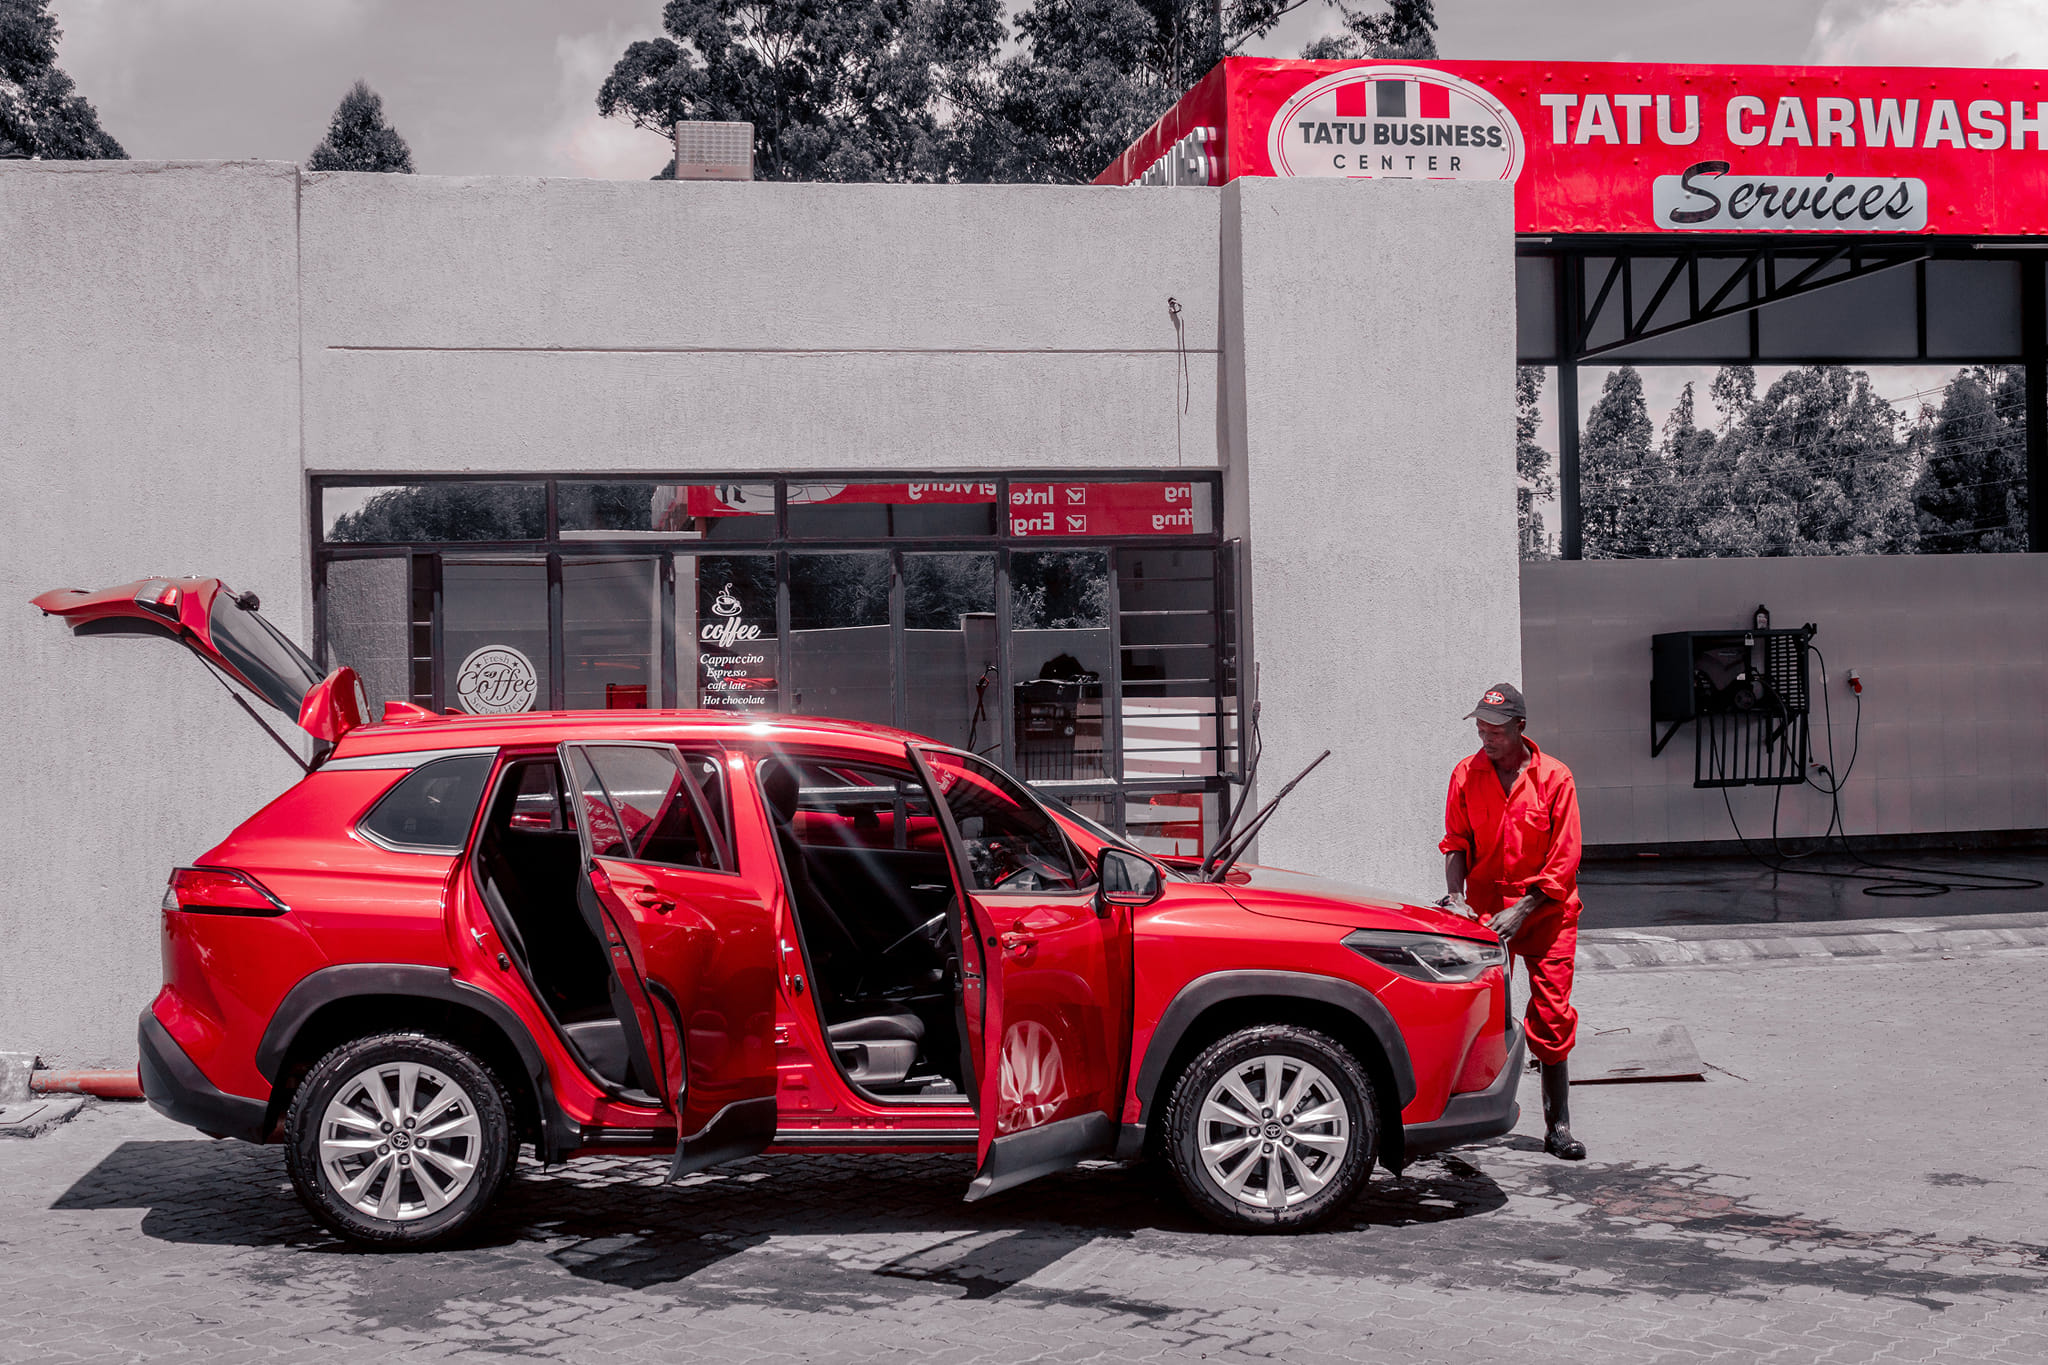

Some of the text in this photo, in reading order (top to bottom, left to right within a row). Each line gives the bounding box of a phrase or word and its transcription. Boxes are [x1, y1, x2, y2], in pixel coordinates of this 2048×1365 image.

[1540, 94, 2048, 150] TATU CARWASH
[1299, 122, 1503, 148] TATU BUSINESS
[1333, 154, 1461, 171] CENTER
[1669, 161, 1914, 224] Services
[701, 617, 761, 647] coffee
[483, 655, 510, 664] Fresh
[700, 653, 764, 667] Cappuccino
[707, 667, 747, 678] Espresso
[457, 668, 537, 701] Coffee
[707, 680, 746, 691] cafe late
[703, 695, 765, 704] Hot chocolate
